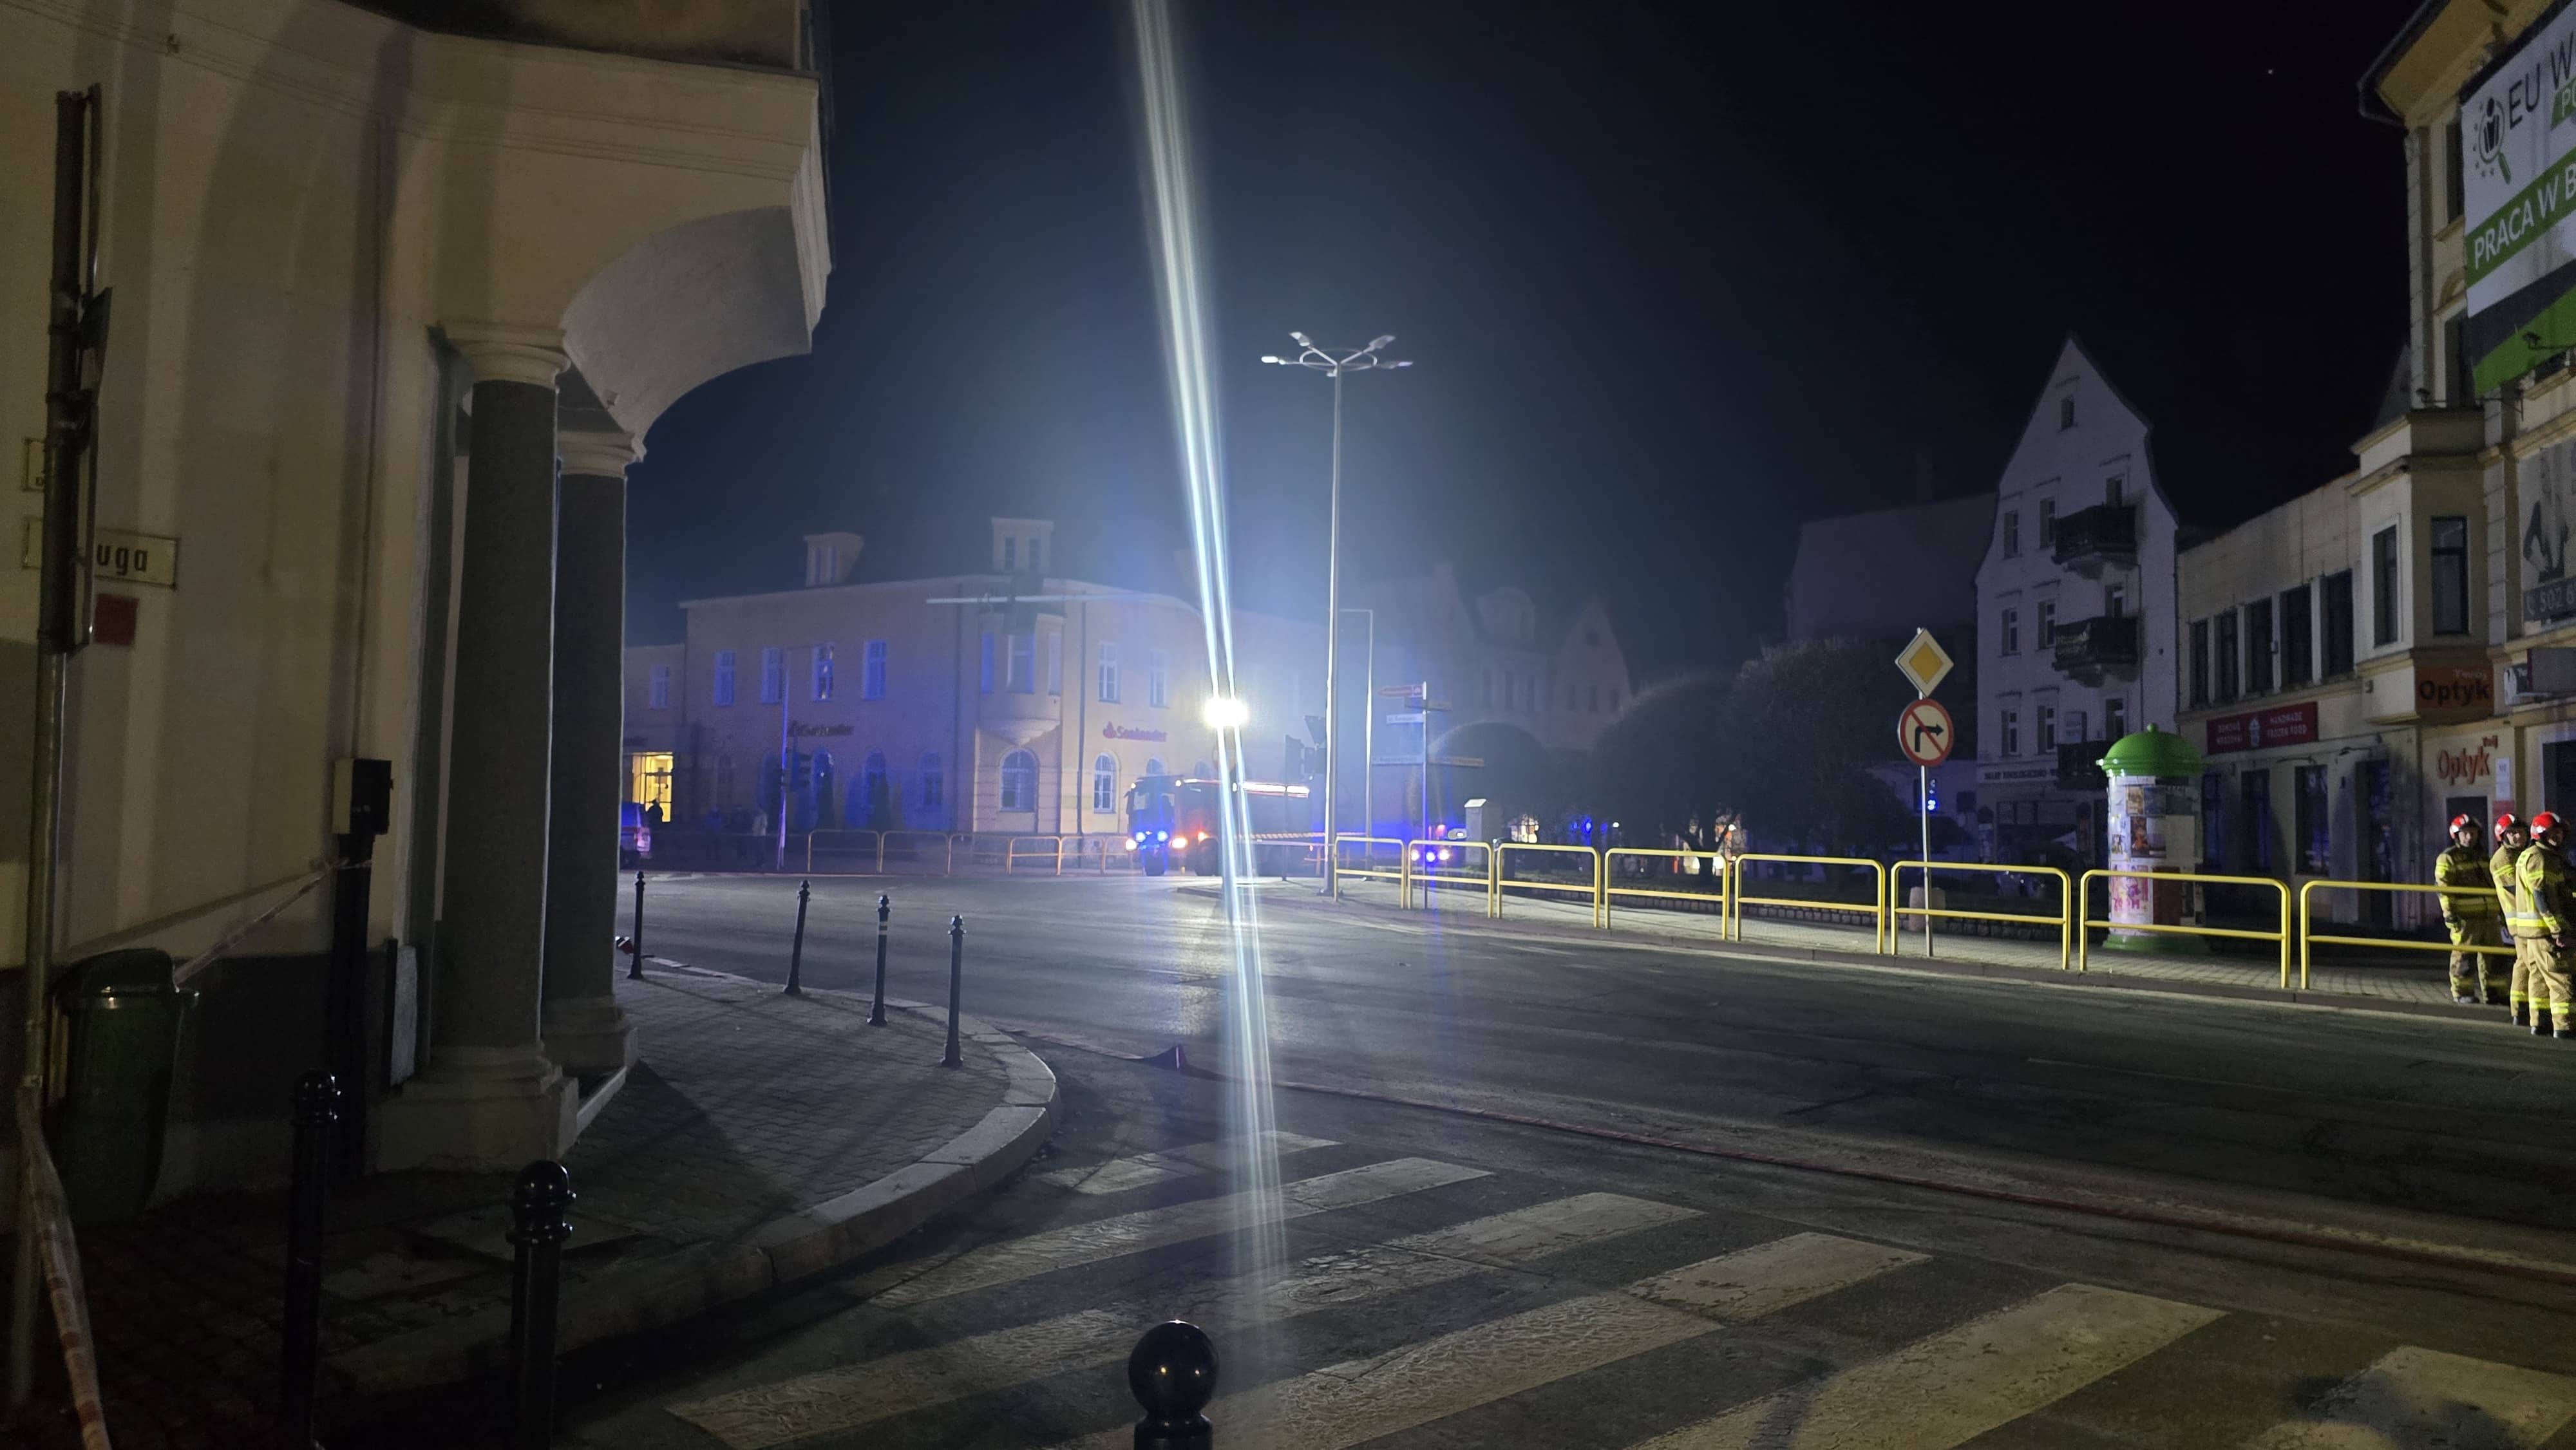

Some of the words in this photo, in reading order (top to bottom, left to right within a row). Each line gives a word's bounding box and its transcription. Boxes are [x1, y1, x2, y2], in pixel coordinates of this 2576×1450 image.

[2509, 62, 2540, 129] EU
[2474, 198, 2535, 271] PRACA
[2537, 173, 2559, 220] W
[97, 543, 148, 576] uga
[2420, 679, 2490, 707] Optyk
[2438, 746, 2490, 786] Optyk
